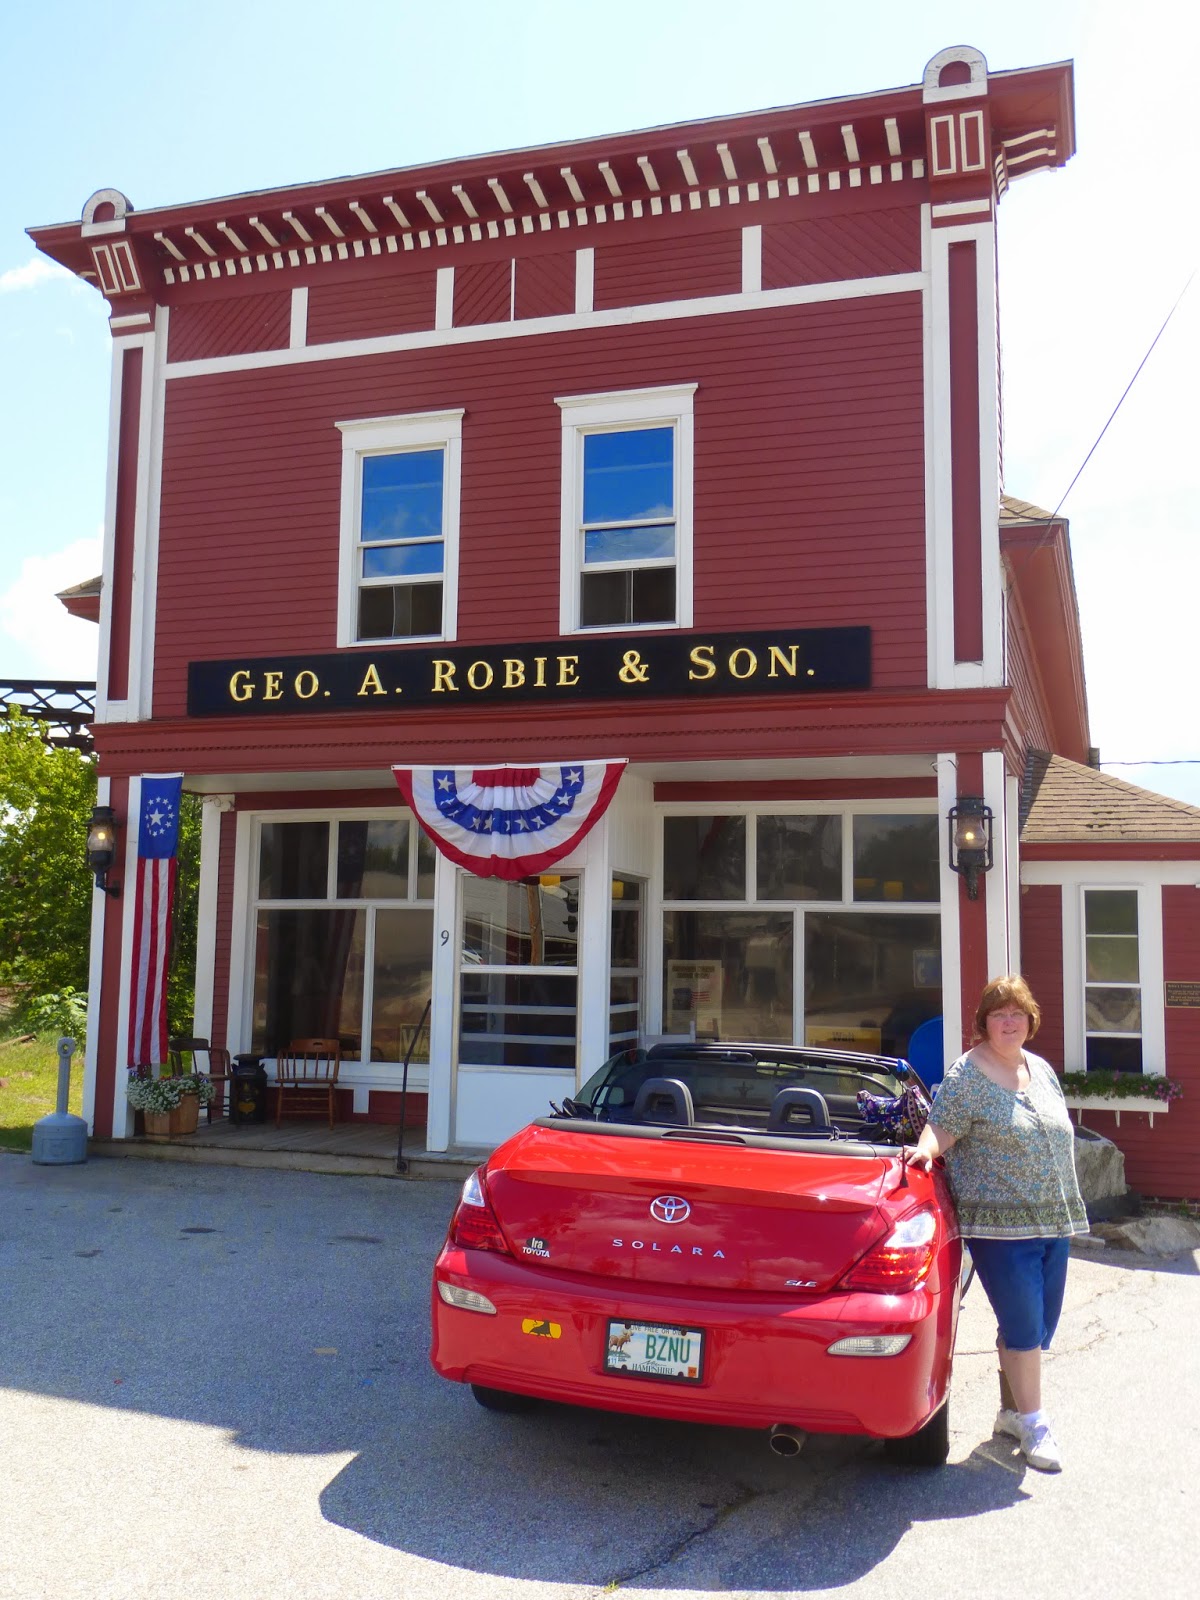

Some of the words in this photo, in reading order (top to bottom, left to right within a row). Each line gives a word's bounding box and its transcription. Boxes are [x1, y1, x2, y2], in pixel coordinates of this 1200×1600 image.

[229, 670, 331, 701] GEO.
[357, 664, 402, 696] A.
[431, 655, 580, 692] ROBIE
[618, 650, 650, 683] &
[688, 645, 815, 680] SON.
[441, 929, 450, 947] 9
[531, 1237, 543, 1249] Ira
[612, 1239, 725, 1259] SOLARA
[522, 1246, 550, 1258] TOYOTA
[784, 1279, 817, 1288] SLE
[645, 1334, 691, 1364] BZNU
[632, 1362, 675, 1375] HAMPSHIRE
